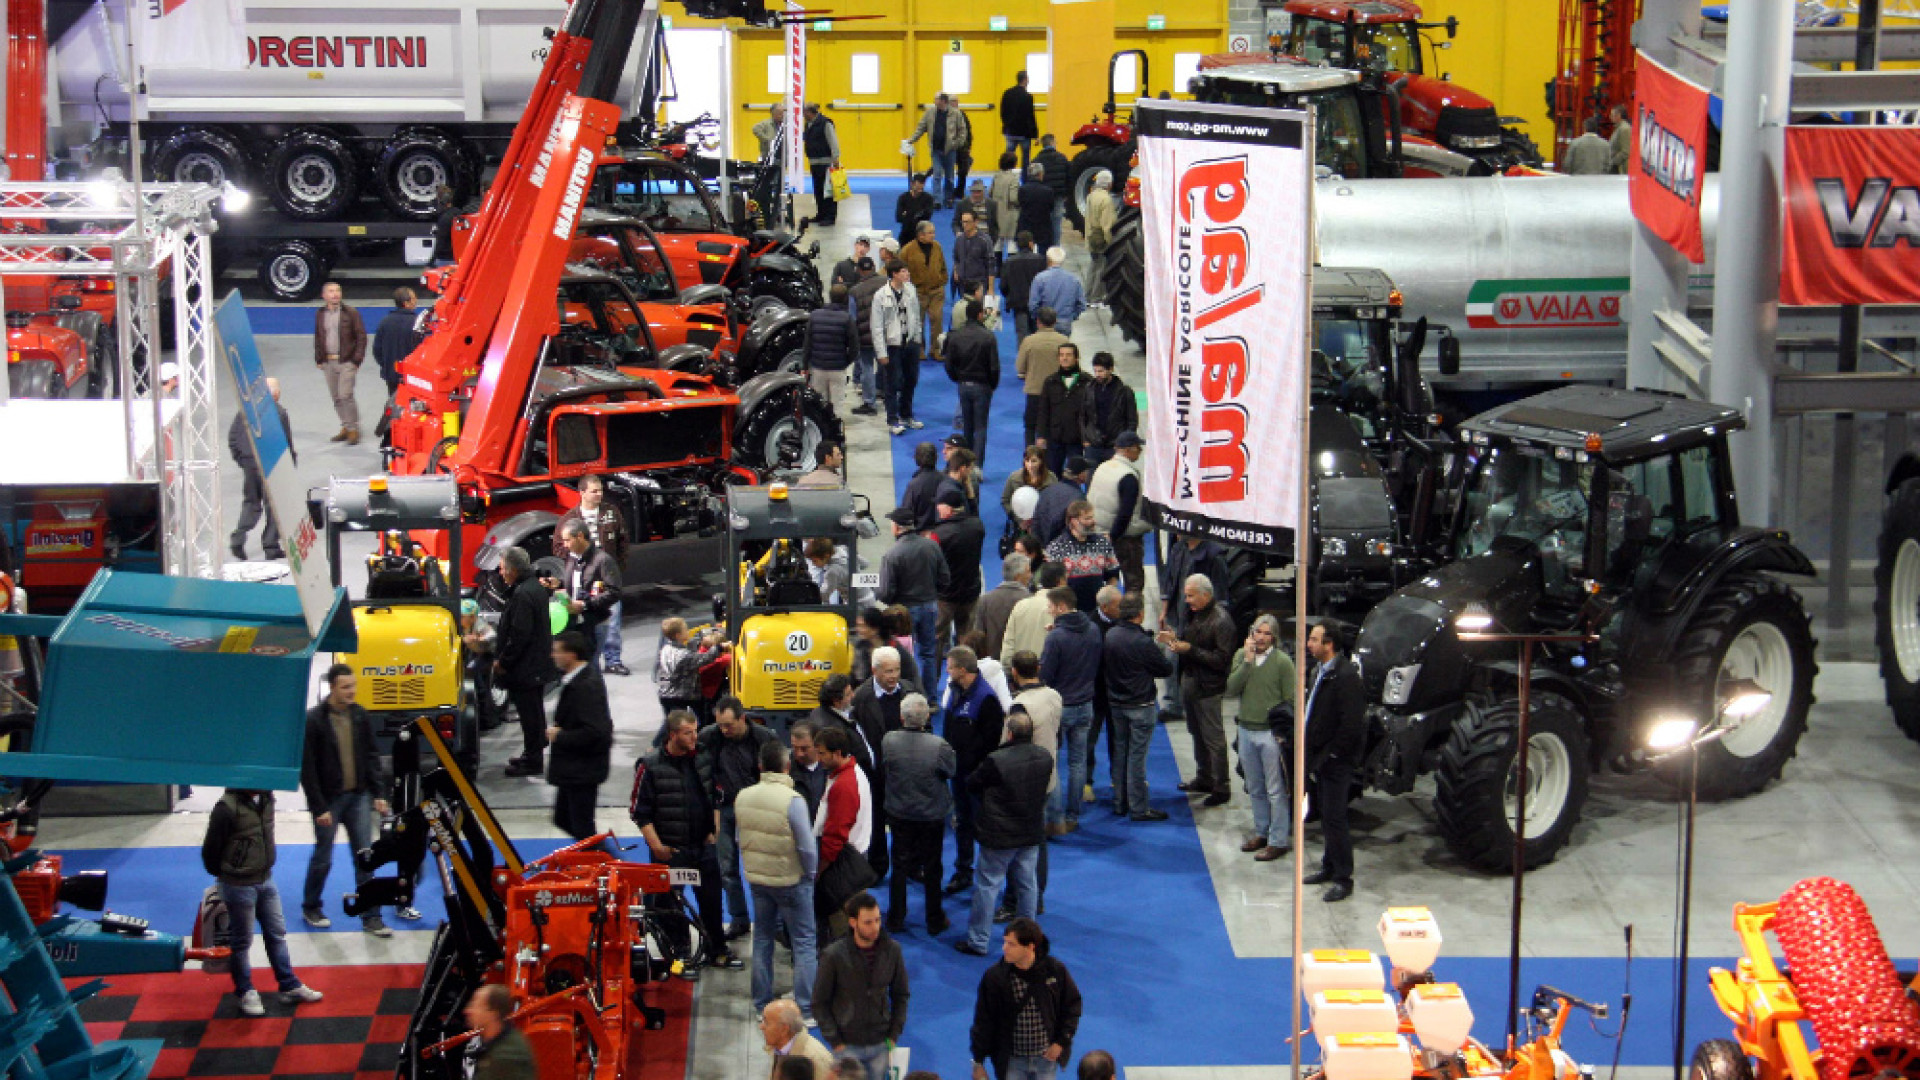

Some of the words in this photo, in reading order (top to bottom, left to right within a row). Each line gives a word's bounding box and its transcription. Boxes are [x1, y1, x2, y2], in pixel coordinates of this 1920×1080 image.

[1639, 102, 1696, 203] VALTRA
[553, 146, 594, 240] MANITOU
[1526, 295, 1594, 320] VAIA
[788, 634, 808, 651] 20
